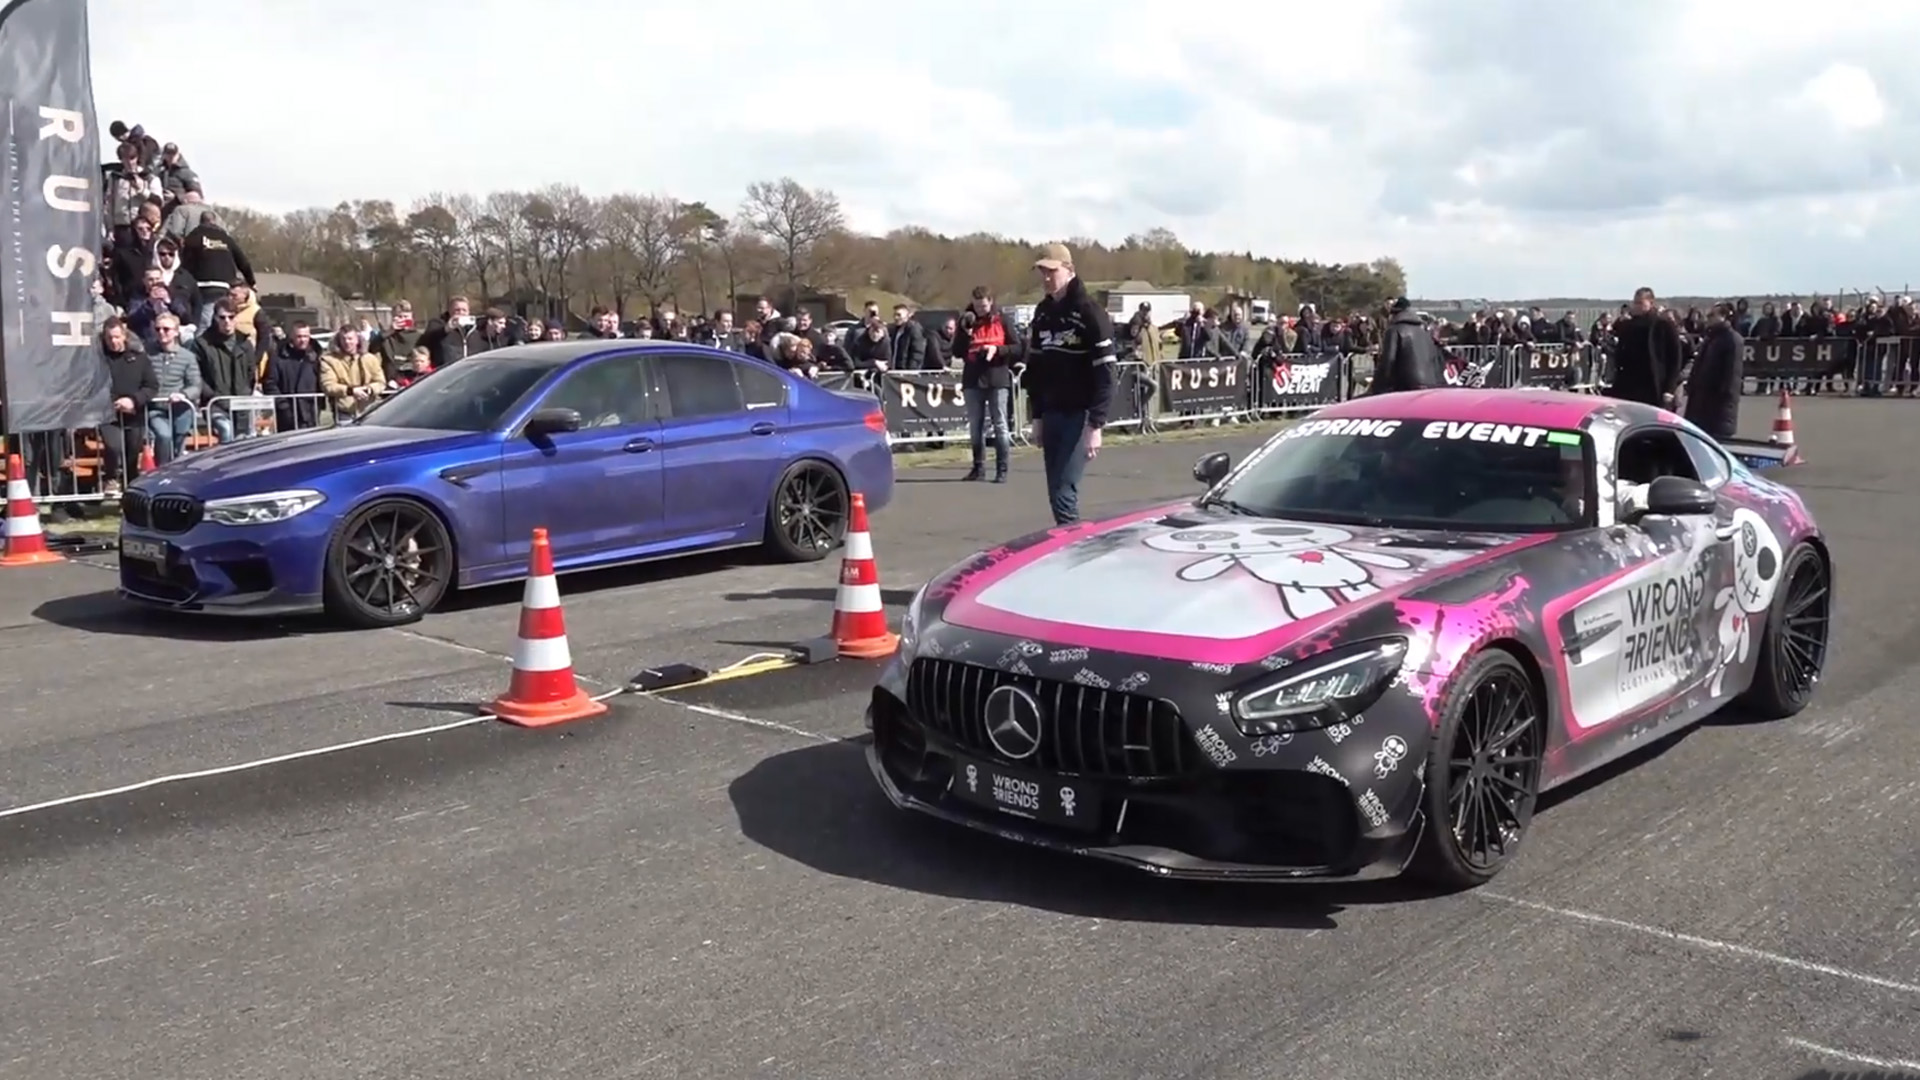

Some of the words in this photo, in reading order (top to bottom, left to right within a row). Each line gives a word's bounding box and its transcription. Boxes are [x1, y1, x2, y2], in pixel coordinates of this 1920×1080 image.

[12, 200, 21, 224] THE
[39, 105, 96, 346] RUSH
[1742, 344, 1832, 361] RUSH
[1171, 366, 1237, 390] RUSH
[900, 383, 966, 407] RUS
[1290, 419, 1402, 438] SPRING
[1422, 421, 1548, 447] EVENT
[1203, 724, 1237, 761] WRONG
[992, 773, 1040, 796] WRONG
[992, 786, 1040, 810] FRIENDS
[1358, 794, 1382, 827] FRIEND
